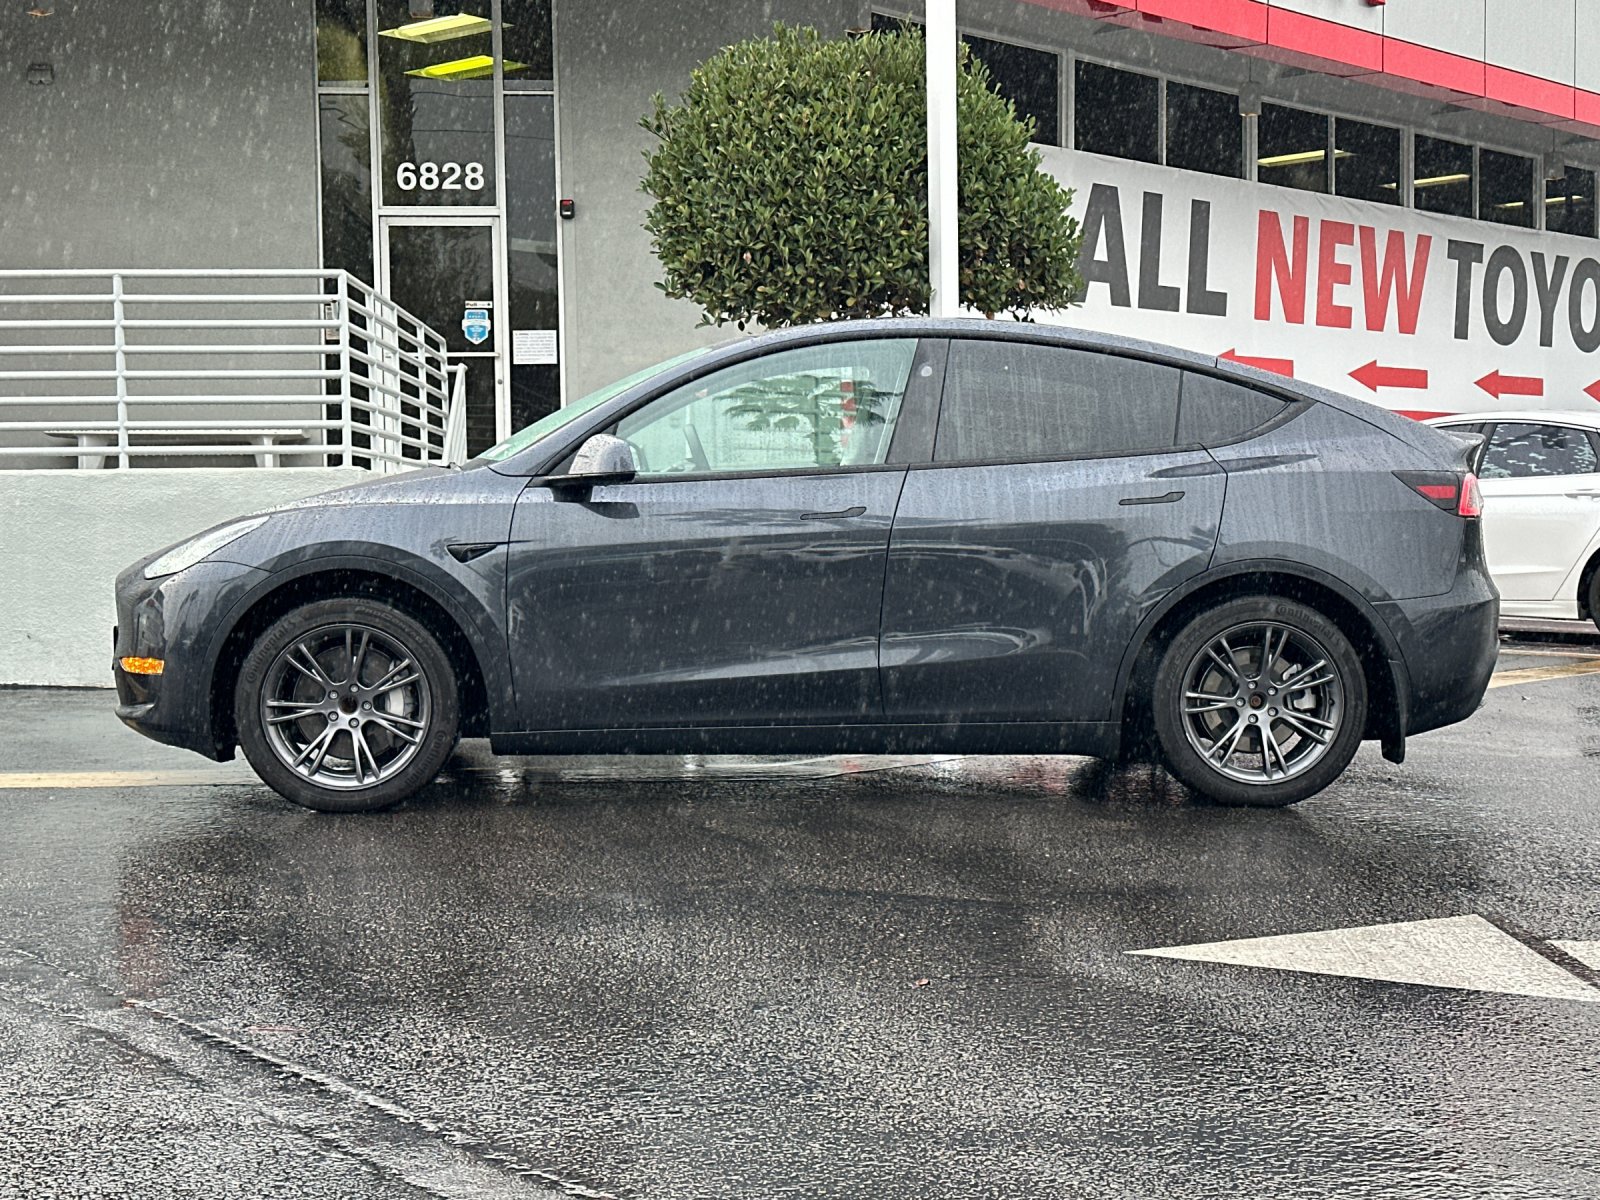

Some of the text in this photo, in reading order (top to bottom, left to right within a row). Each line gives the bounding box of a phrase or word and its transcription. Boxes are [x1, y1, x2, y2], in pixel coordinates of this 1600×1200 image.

[396, 162, 484, 190] 6828
[1078, 183, 1600, 353] ALL NEW TOYO
[246, 622, 288, 683] Continental
